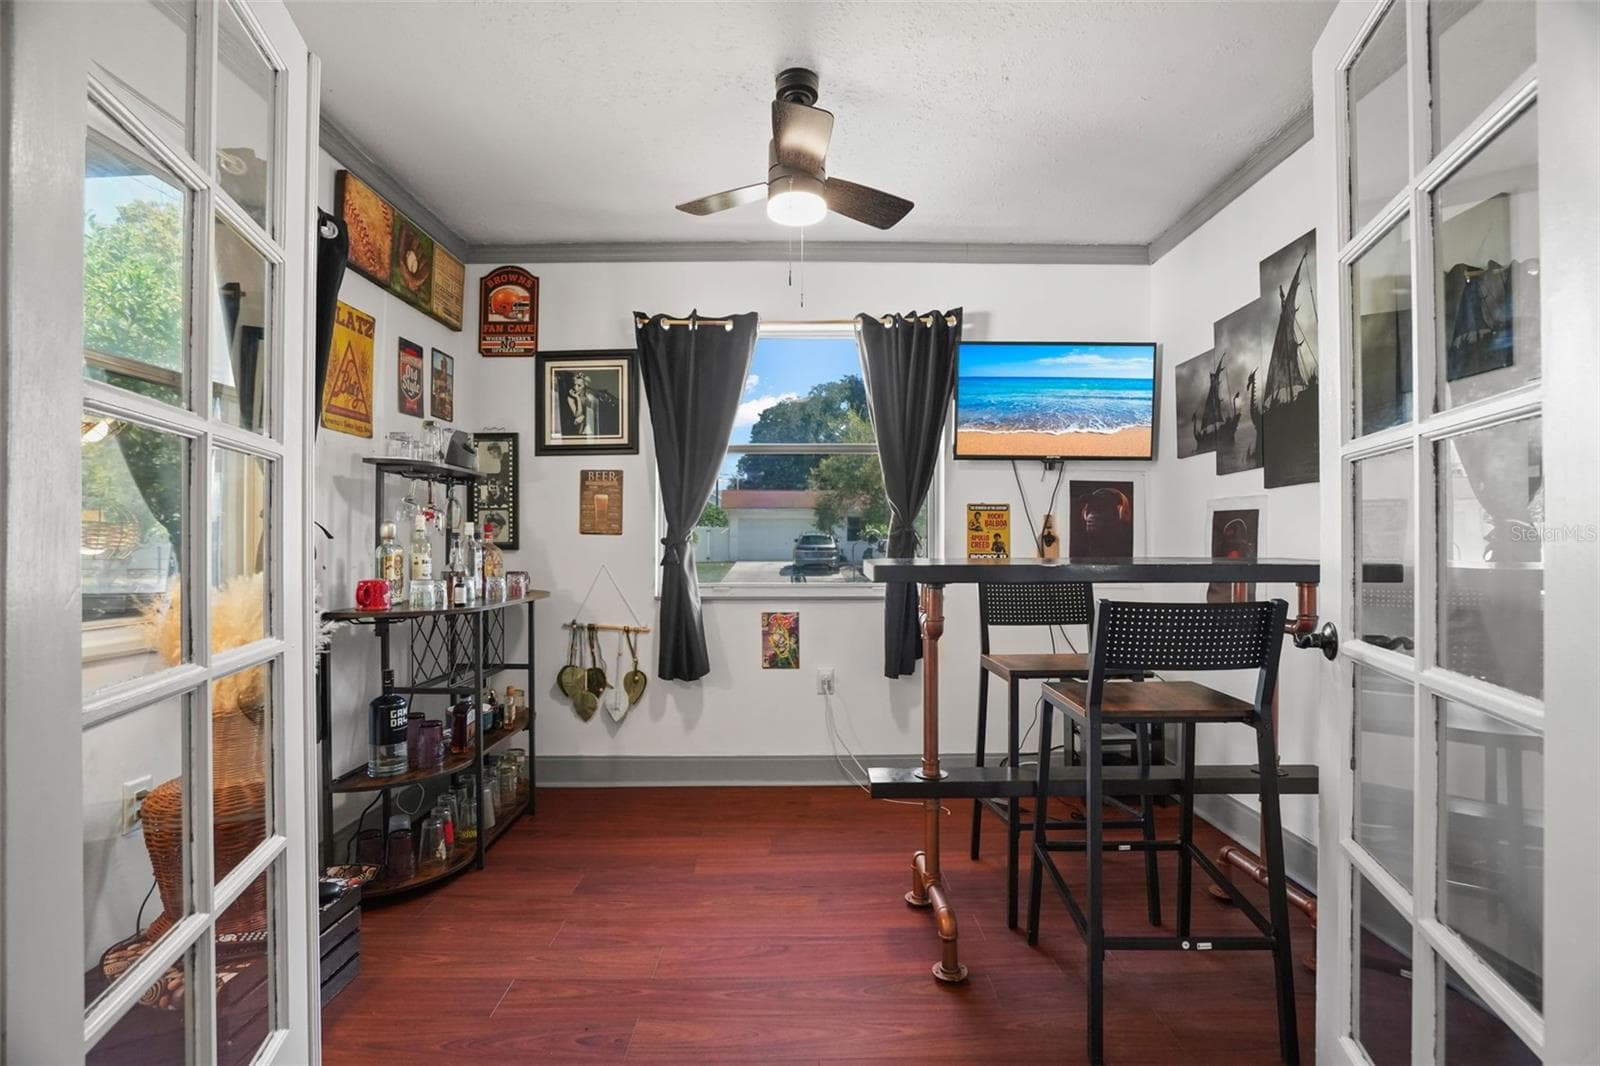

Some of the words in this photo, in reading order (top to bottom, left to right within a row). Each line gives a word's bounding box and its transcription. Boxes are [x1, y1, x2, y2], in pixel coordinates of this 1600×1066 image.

[486, 273, 533, 288] BROWNS
[335, 305, 376, 340] LATZ
[484, 324, 503, 333] FAN
[507, 324, 535, 333] CAVE
[500, 340, 516, 348] NO
[588, 471, 617, 481] BEER
[984, 519, 1007, 527] BALBOA
[970, 541, 990, 549] CREED
